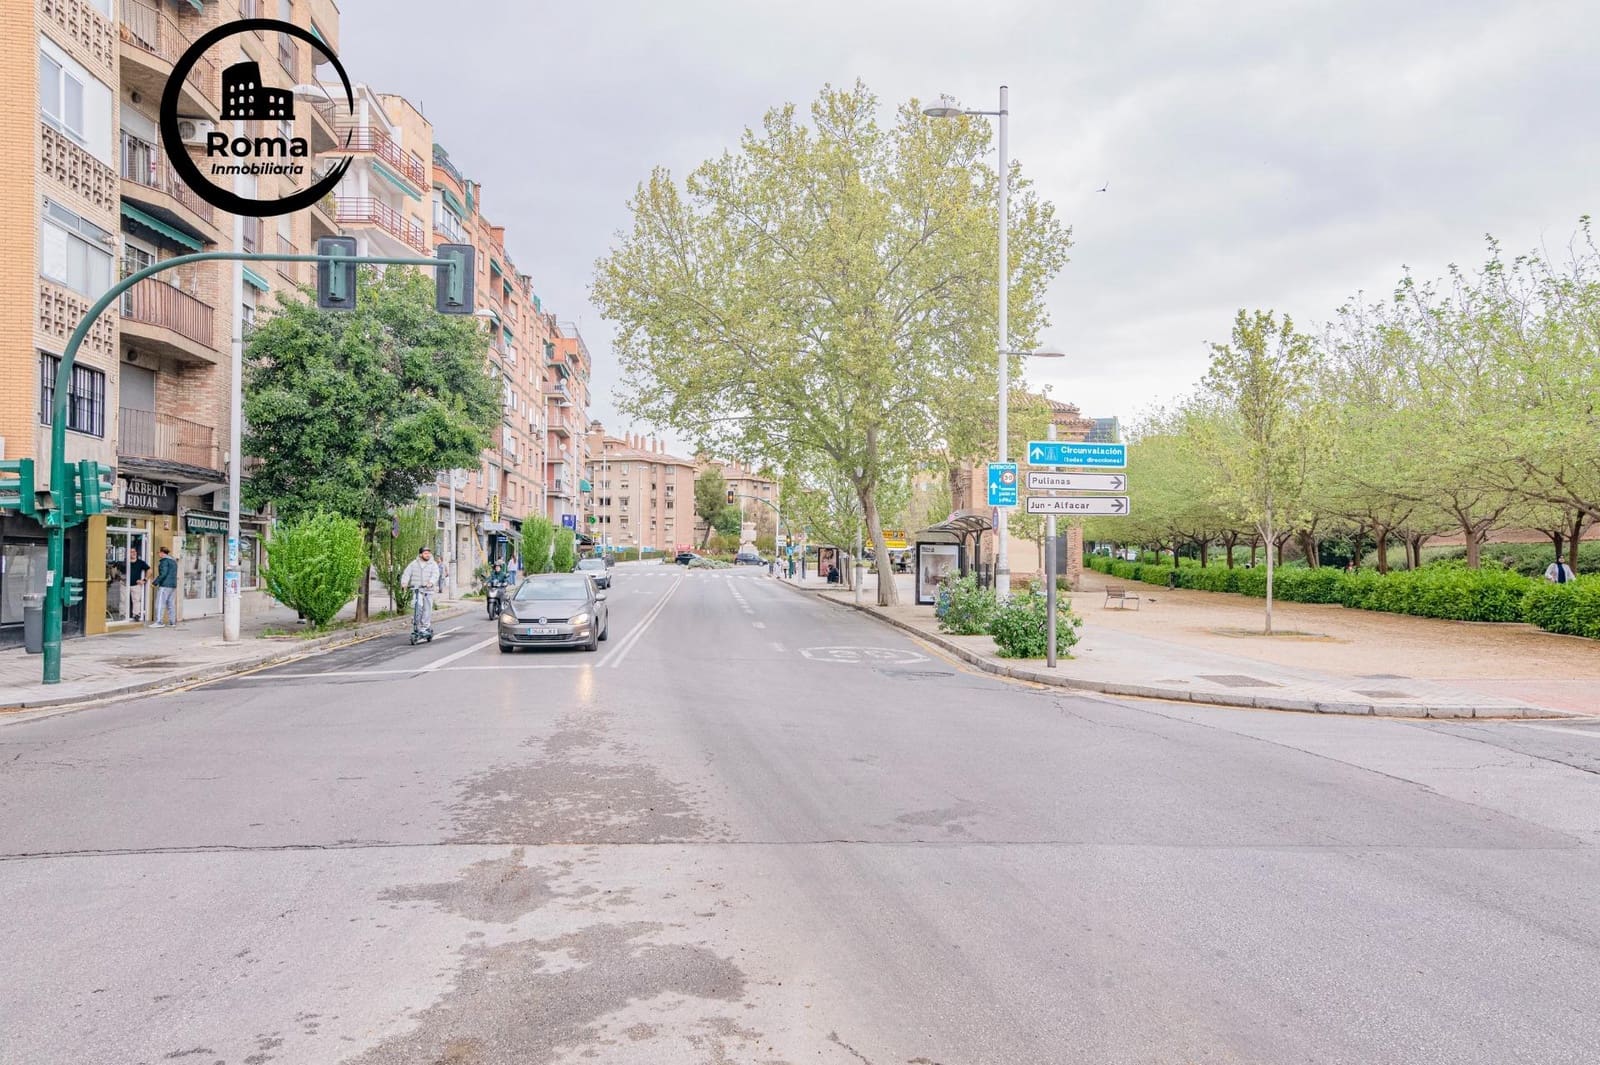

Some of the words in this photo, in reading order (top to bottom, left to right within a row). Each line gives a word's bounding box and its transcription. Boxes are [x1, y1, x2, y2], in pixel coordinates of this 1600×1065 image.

[1060, 446, 1123, 456] Circunvalación
[1032, 477, 1071, 485] Pulianas
[127, 480, 168, 497] ARBERIA
[127, 494, 159, 509] EDUAR
[1054, 502, 1090, 510] Alfacar
